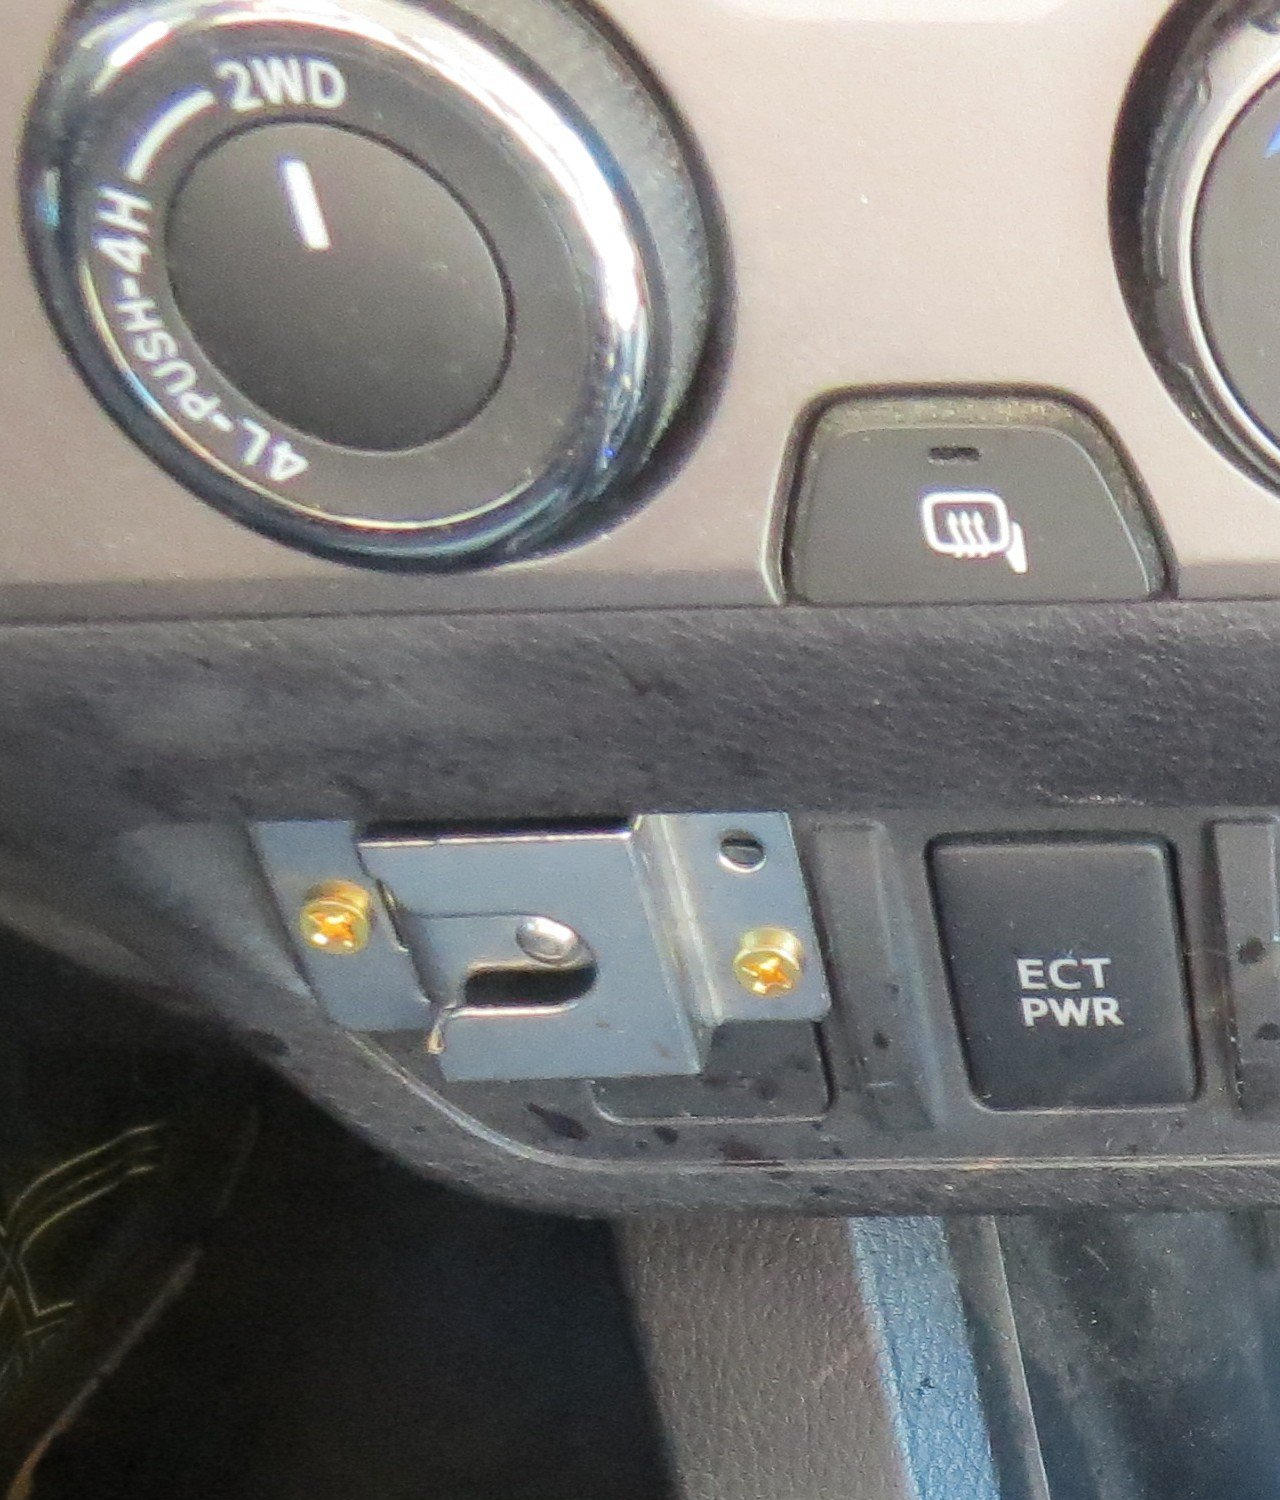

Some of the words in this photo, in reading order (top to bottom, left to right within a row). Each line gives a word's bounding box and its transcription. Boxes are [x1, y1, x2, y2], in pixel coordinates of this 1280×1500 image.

[215, 56, 347, 111] 2WD
[1016, 957, 1112, 990] ECT
[1019, 996, 1125, 1028] PWR
